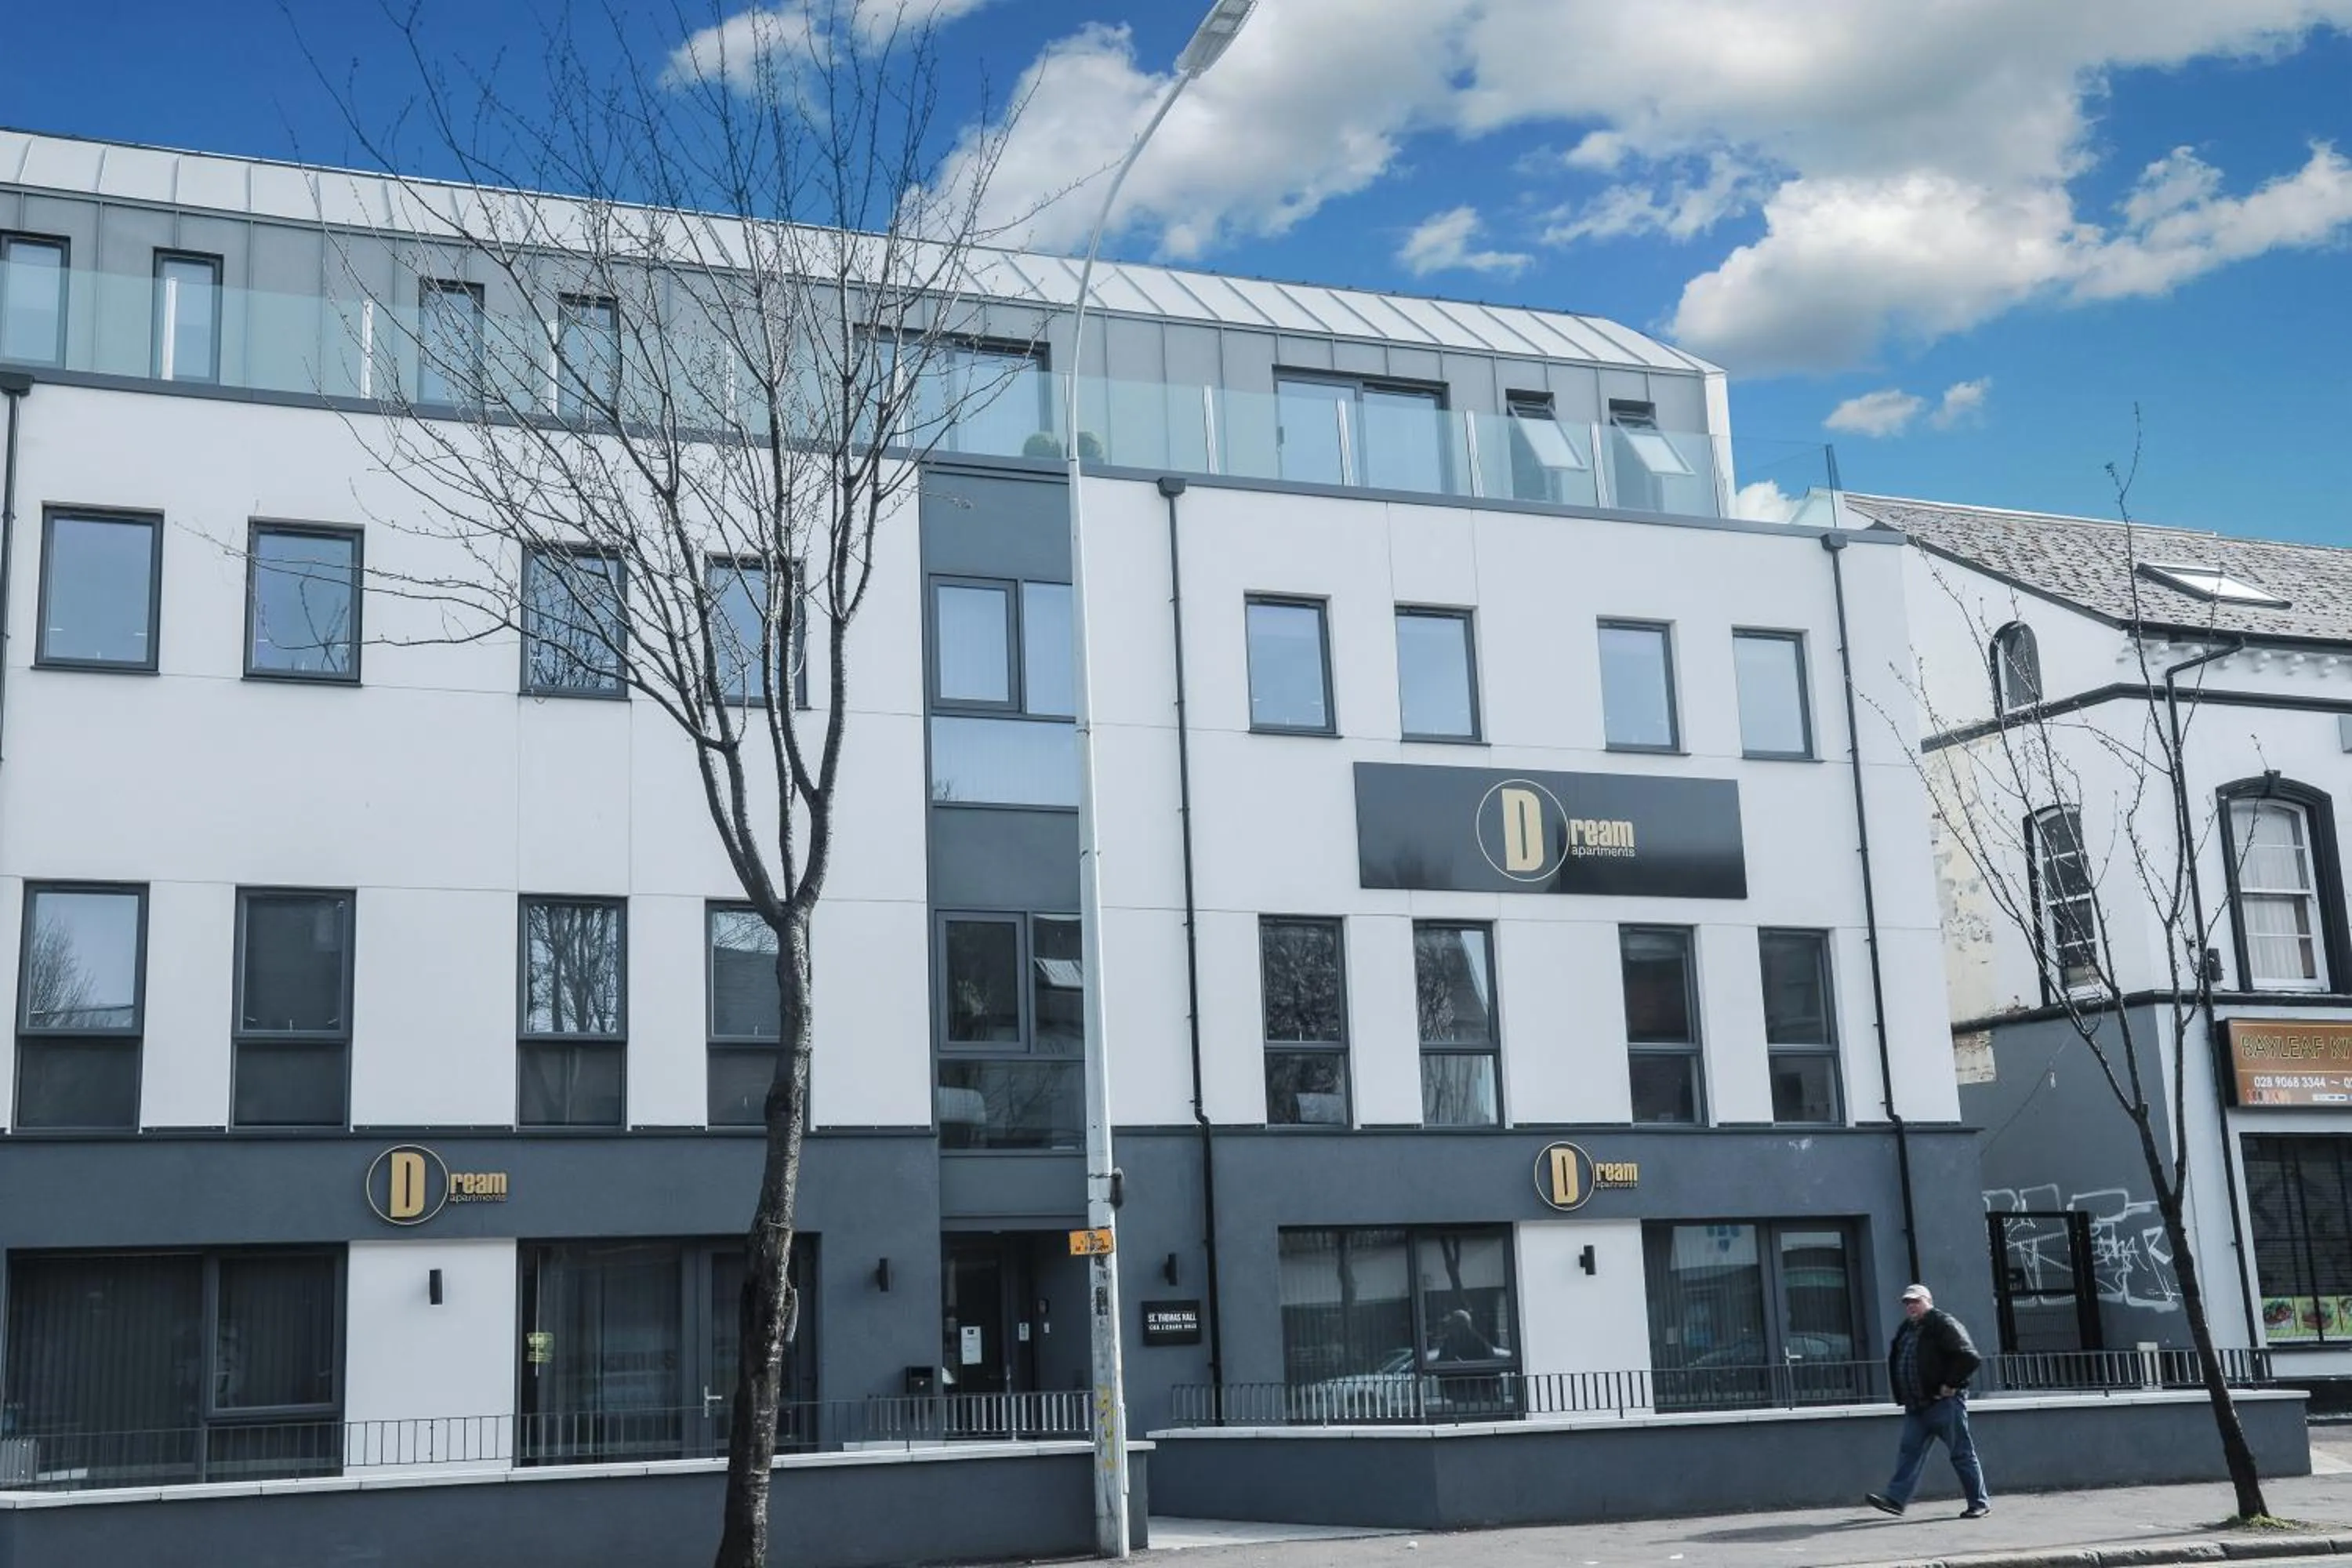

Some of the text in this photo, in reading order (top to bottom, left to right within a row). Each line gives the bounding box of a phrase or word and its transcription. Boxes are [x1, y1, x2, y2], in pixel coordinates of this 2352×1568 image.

[1571, 846, 1635, 858] apartments
[2240, 1034, 2325, 1059] BAYLEAF
[2254, 1076, 2273, 1087] 028
[2274, 1076, 2299, 1088] 9068
[2301, 1076, 2326, 1088] 3344
[449, 1192, 507, 1203] apartments
